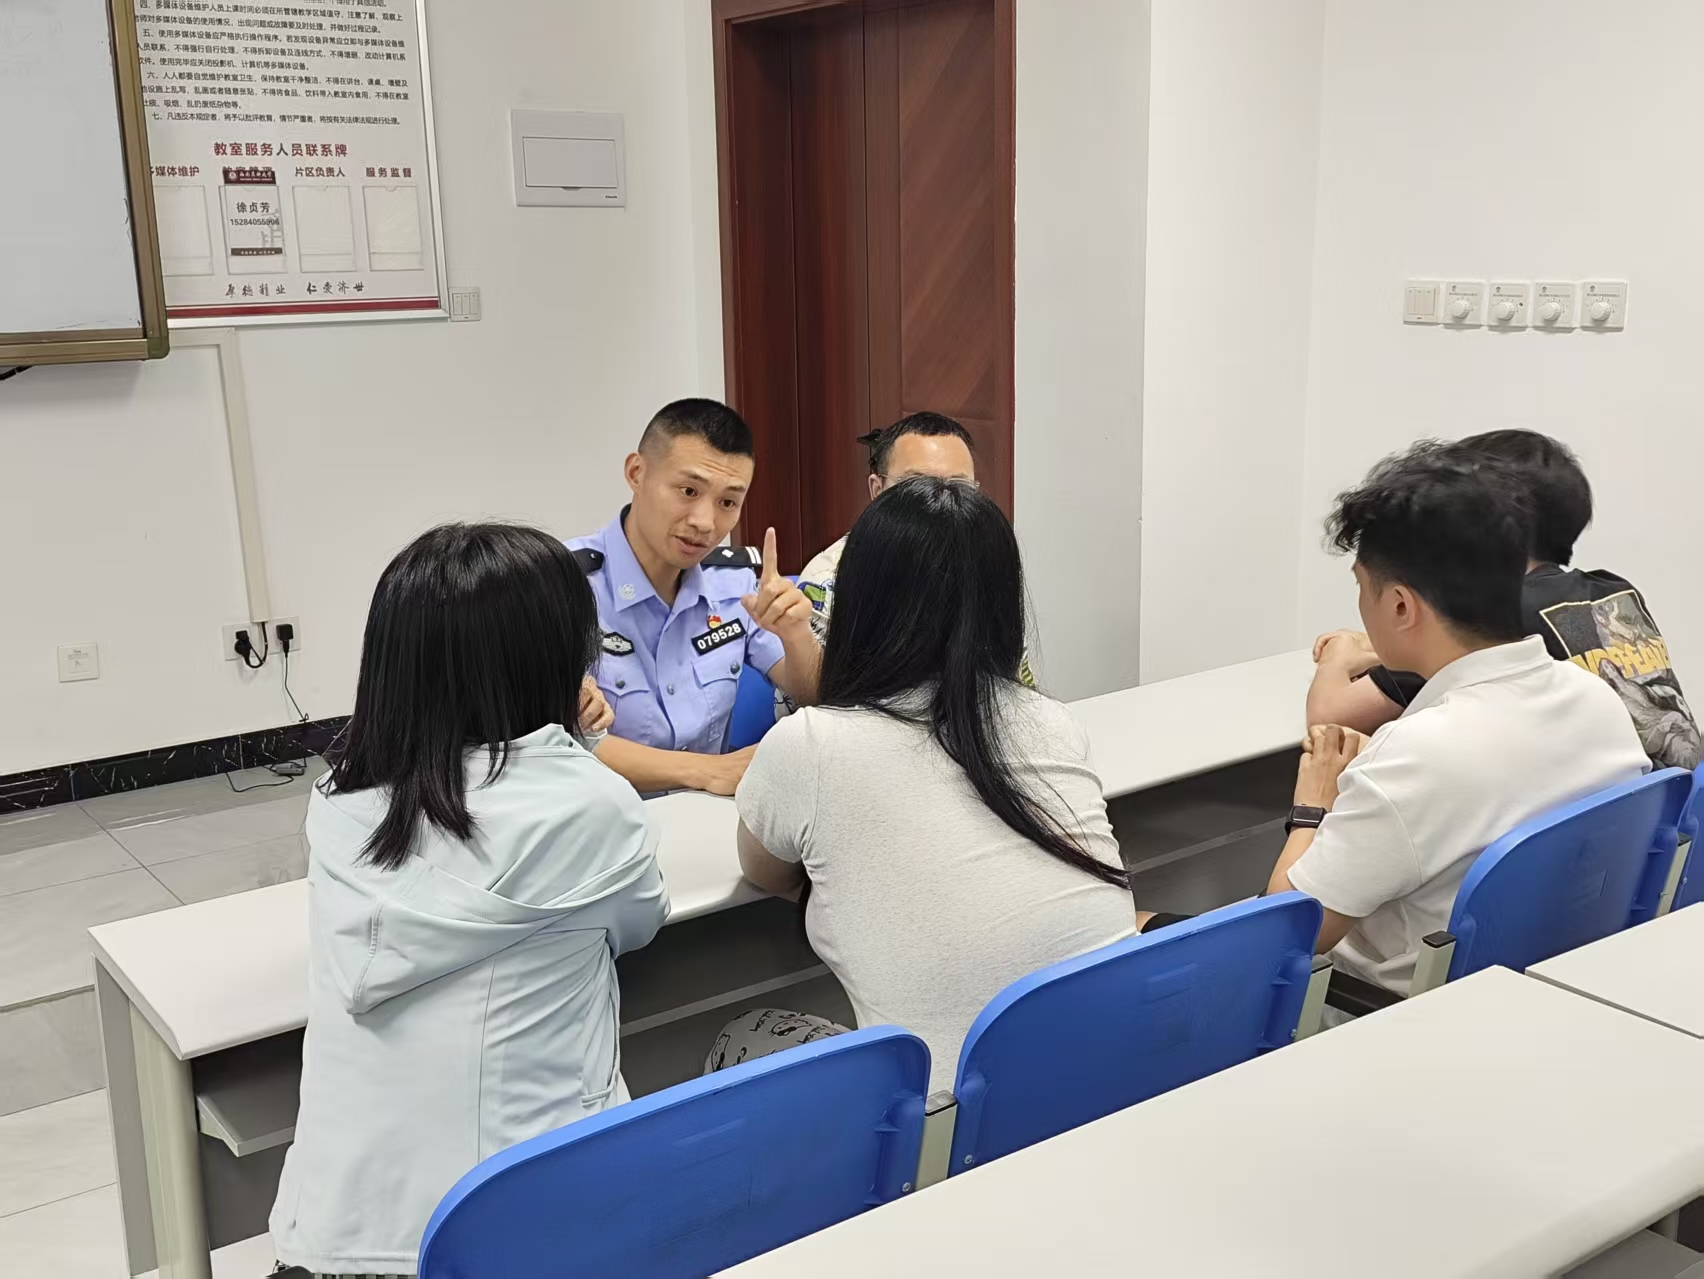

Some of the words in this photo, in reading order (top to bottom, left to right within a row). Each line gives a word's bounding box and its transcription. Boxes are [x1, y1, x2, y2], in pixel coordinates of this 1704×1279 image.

[214, 142, 348, 157] 教室服务人员联系牌
[295, 166, 346, 178] 片区负责人
[366, 167, 412, 178] 服务监督
[236, 201, 271, 213] 徐贞芳
[697, 623, 741, 649] 079528
